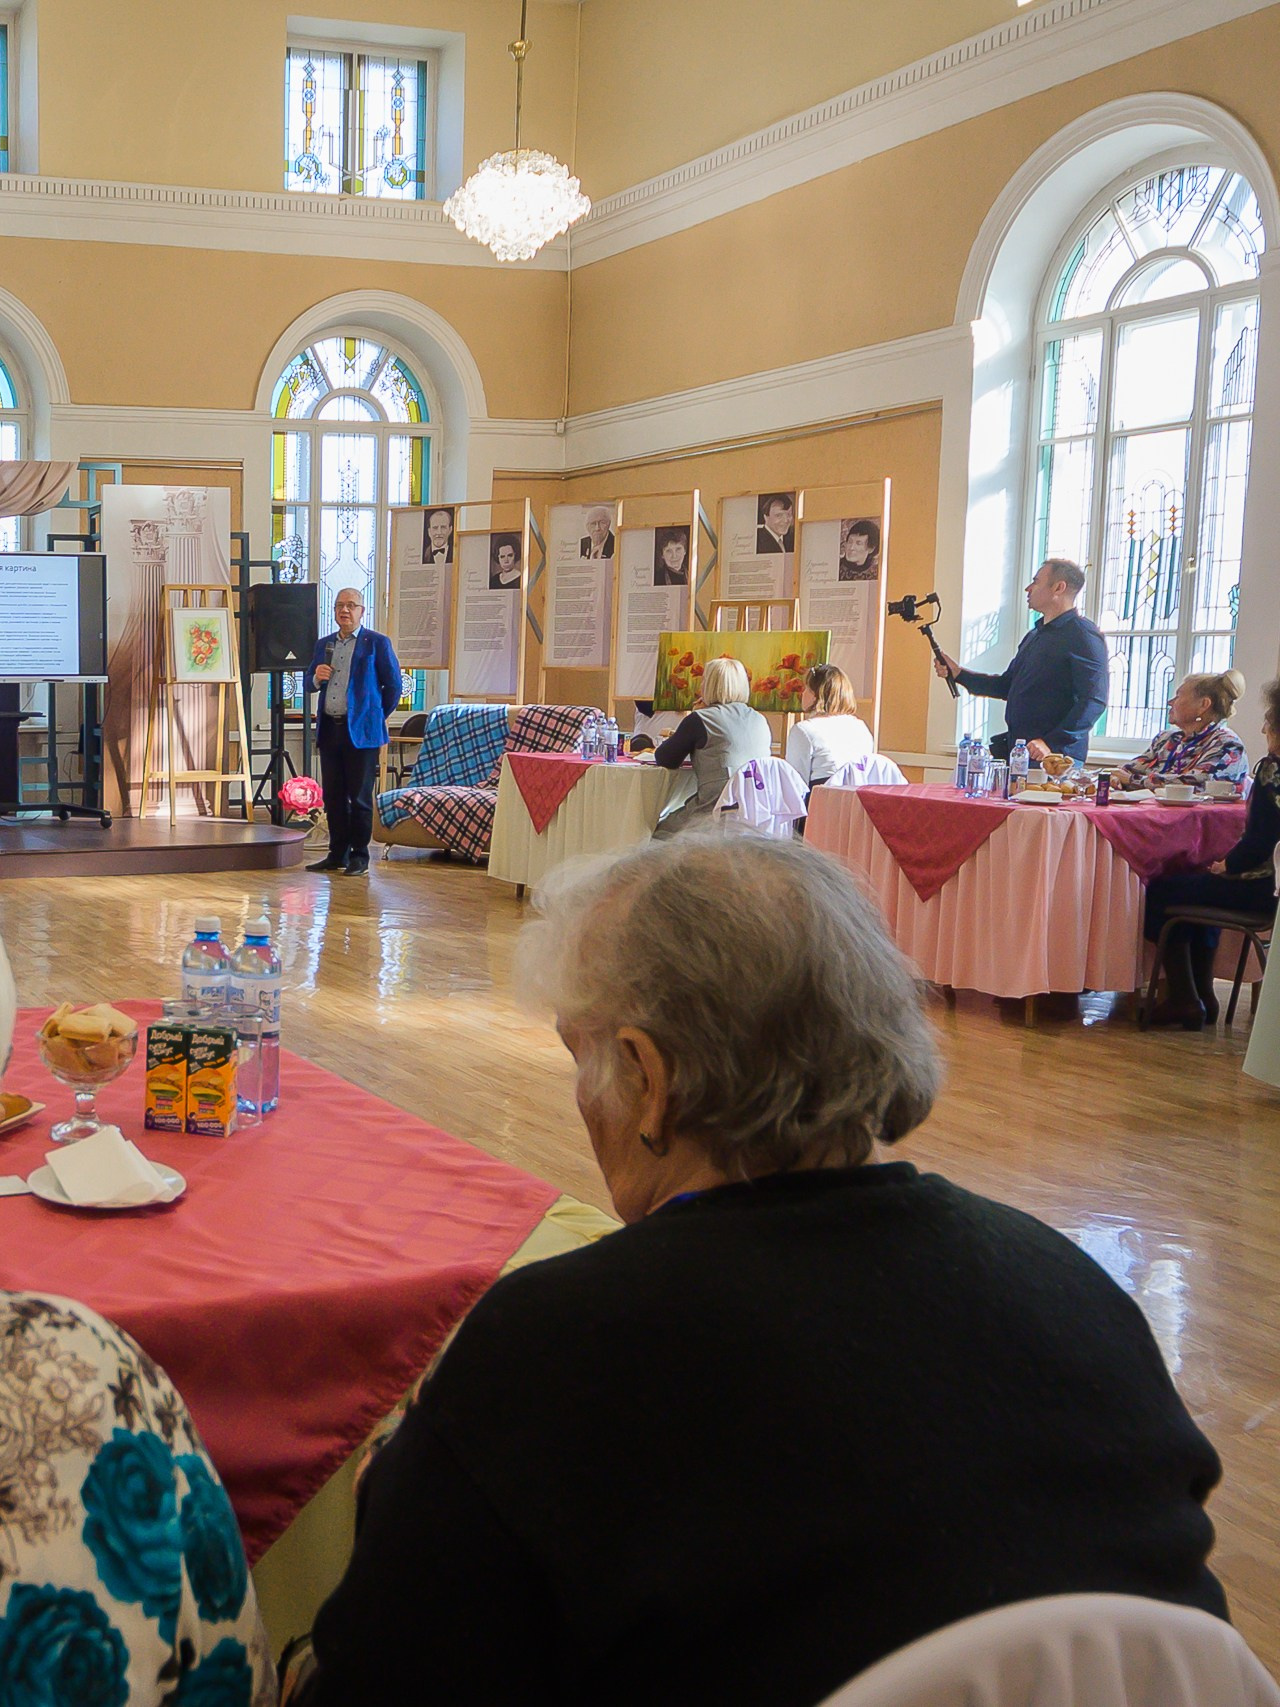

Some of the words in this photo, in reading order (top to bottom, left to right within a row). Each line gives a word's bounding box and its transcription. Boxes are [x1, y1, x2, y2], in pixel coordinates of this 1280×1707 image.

[5, 565, 37, 574] картина
[150, 1029, 183, 1042] Добрый
[192, 1033, 225, 1046] Добрый
